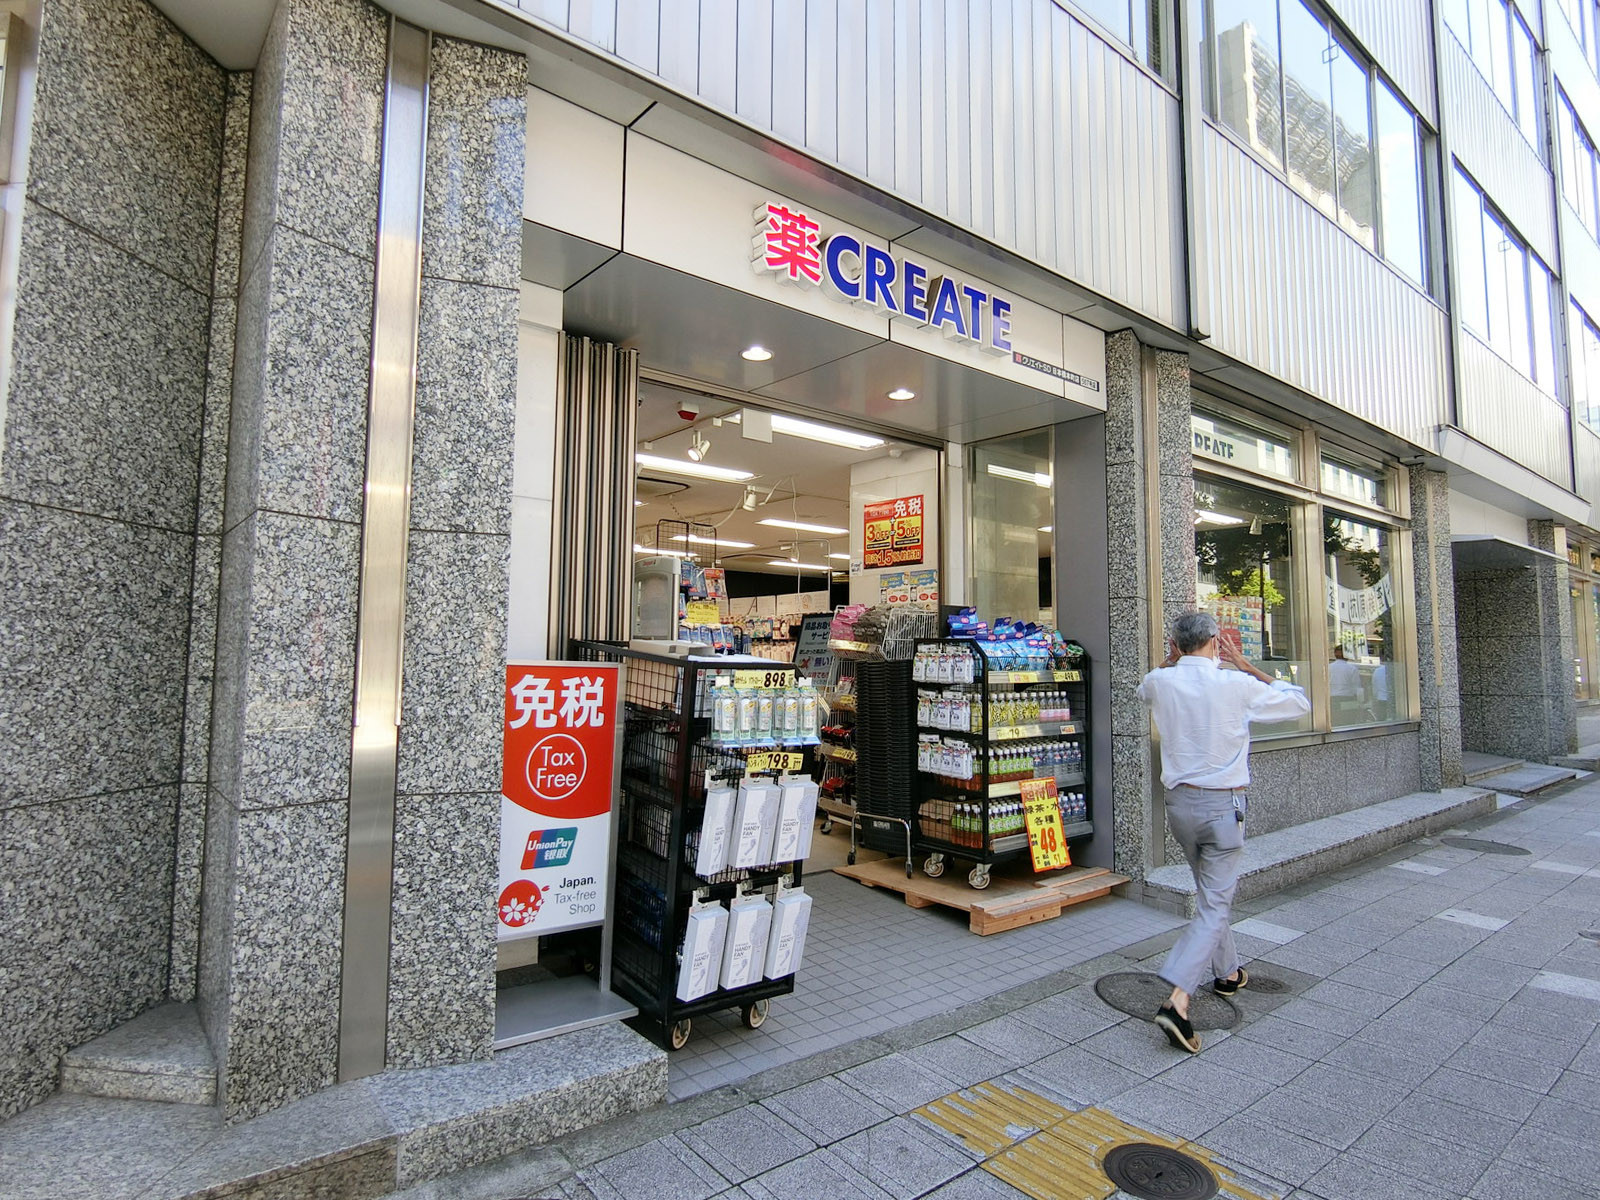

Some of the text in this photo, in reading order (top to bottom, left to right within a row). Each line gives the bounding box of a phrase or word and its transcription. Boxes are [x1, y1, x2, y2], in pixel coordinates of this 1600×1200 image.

[765, 204, 1012, 351] 薬 CREATE
[894, 497, 922, 518] 免税
[763, 672, 786, 688] 898
[509, 674, 605, 730] 免税
[541, 746, 576, 767] Tax
[536, 768, 578, 789] Free
[1024, 801, 1060, 814] 緑茶・水
[527, 837, 574, 851] UnionPay
[1040, 826, 1057, 854] 48
[559, 876, 597, 889] Japan.
[554, 890, 597, 904] Tax-free
[569, 903, 596, 915] Shop
